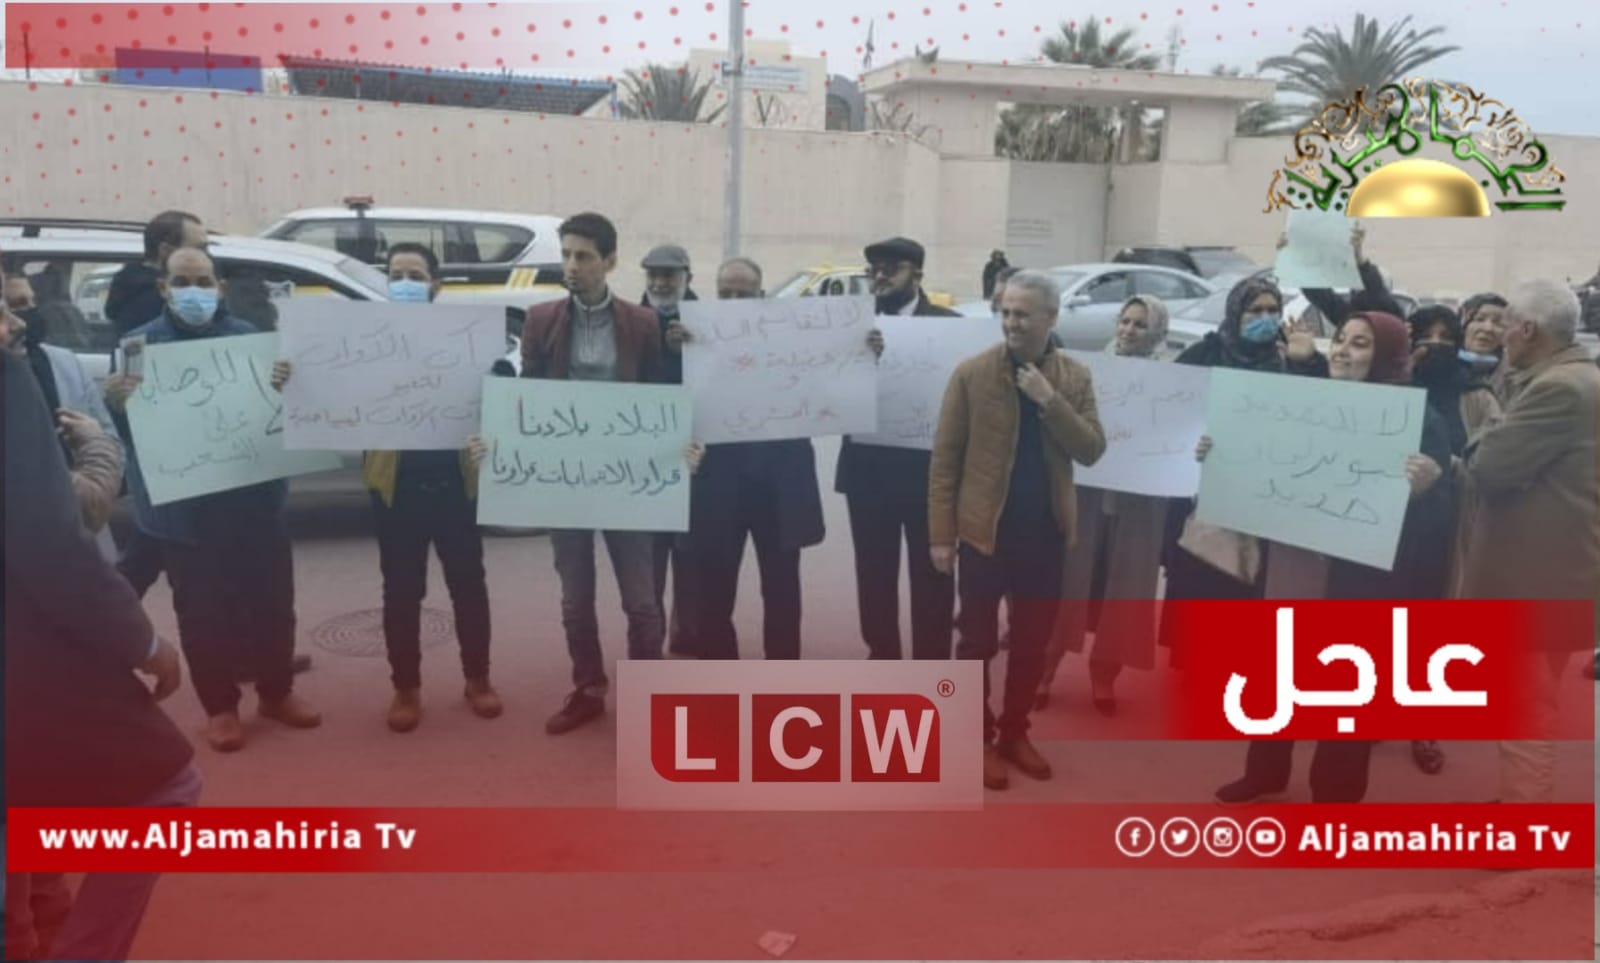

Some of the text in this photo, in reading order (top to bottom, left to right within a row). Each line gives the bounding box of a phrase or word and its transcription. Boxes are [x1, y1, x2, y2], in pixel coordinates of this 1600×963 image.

[517, 393, 679, 439] البلاد بلادنا
[1374, 397, 1410, 437] لا
[490, 438, 538, 486] قرارنا
[628, 456, 682, 497] قرار
